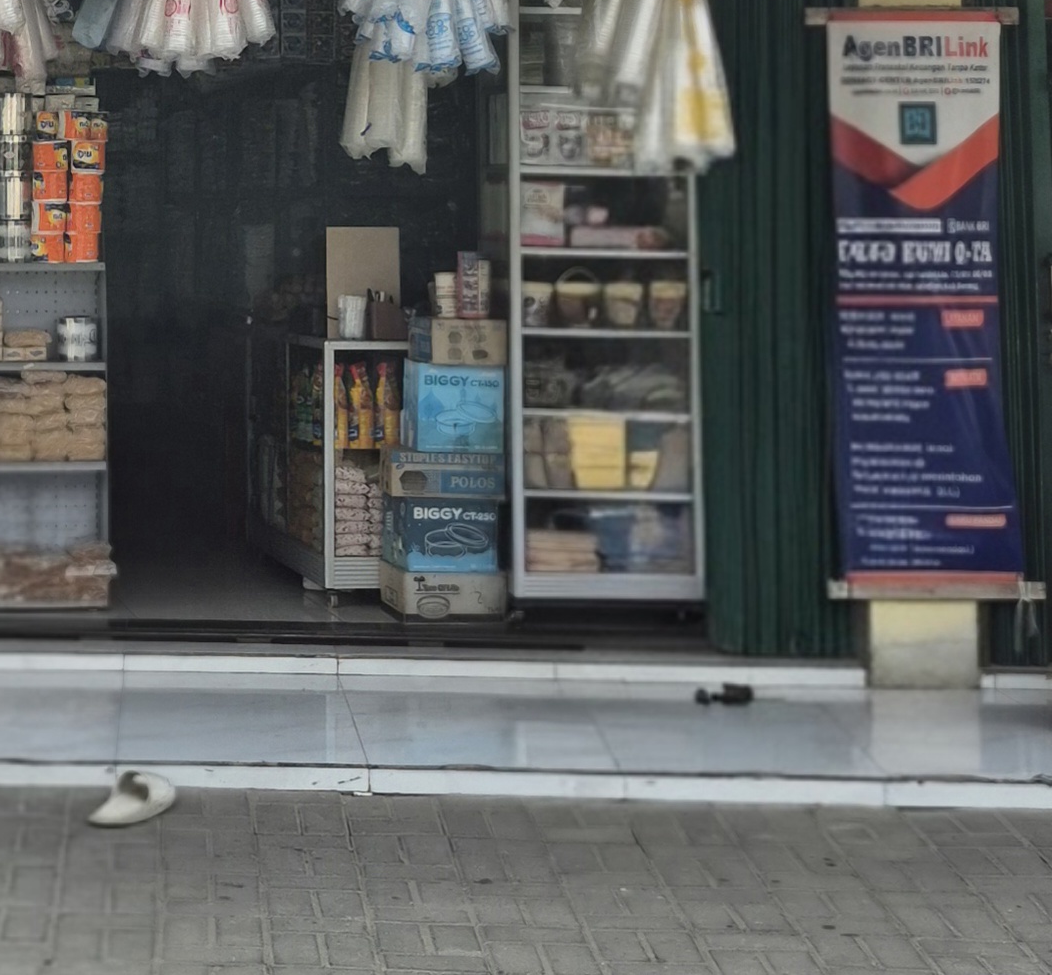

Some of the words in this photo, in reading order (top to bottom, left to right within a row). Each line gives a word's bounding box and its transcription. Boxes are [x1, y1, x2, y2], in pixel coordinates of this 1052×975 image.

[842, 35, 988, 62] AgenBRILink
[424, 374, 469, 386] BIGGY
[450, 475, 496, 489] POLOS
[413, 506, 463, 520] BIGGY
